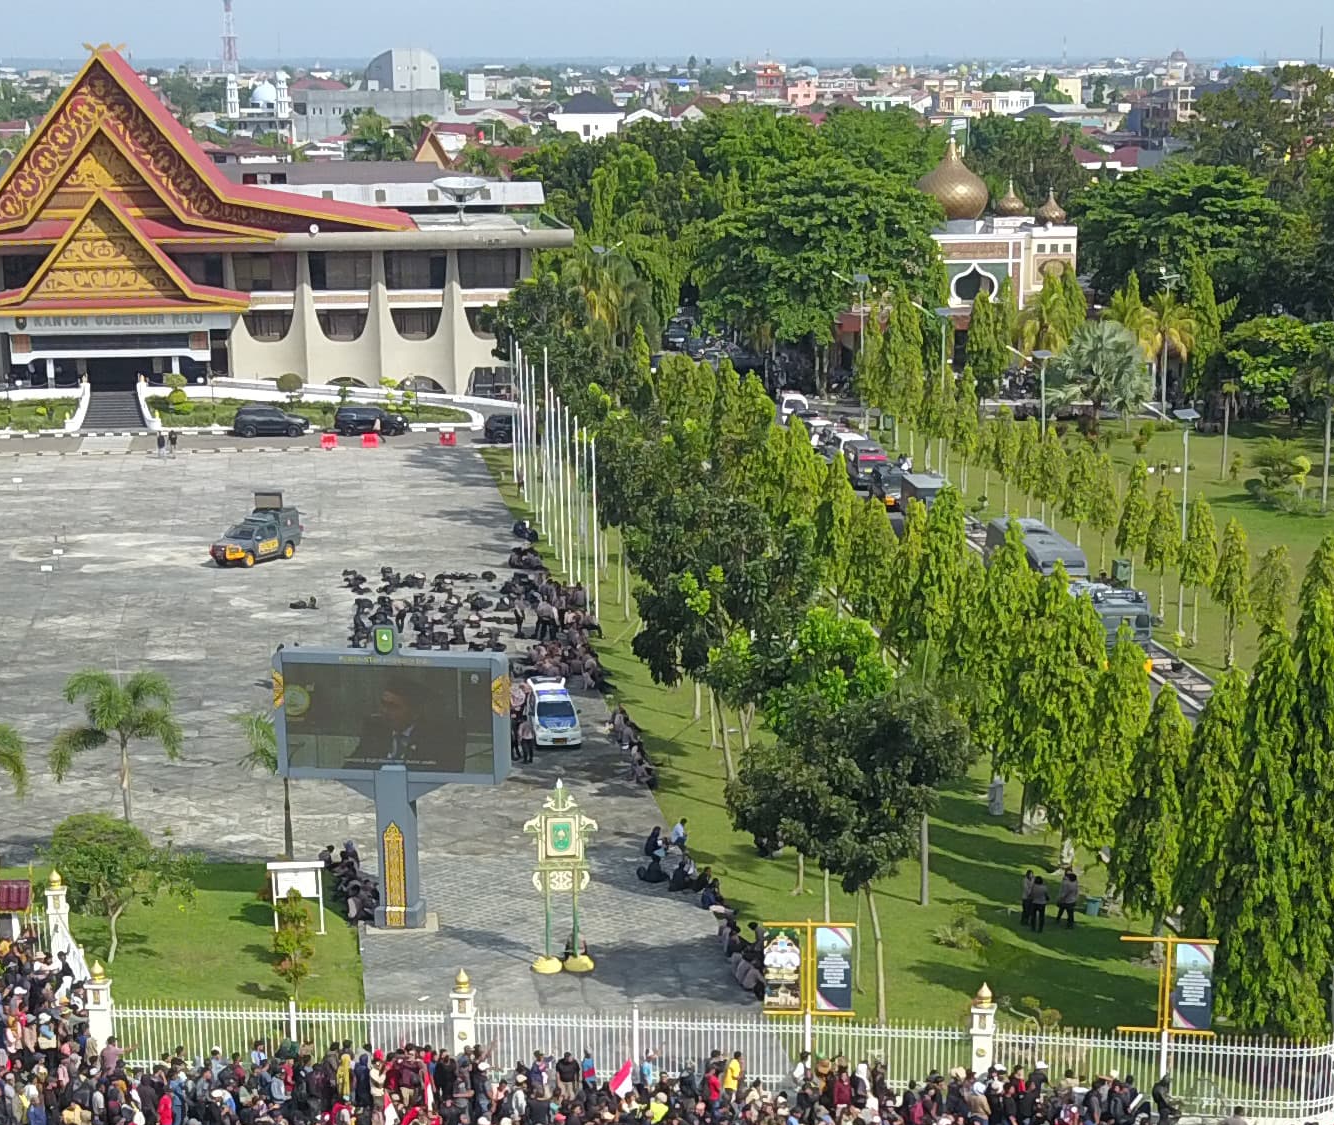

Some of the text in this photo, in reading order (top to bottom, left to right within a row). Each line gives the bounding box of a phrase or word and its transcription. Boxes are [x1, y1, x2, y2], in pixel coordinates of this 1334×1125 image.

[34, 313, 204, 327] KANTOR GUBERNUR RIAU
